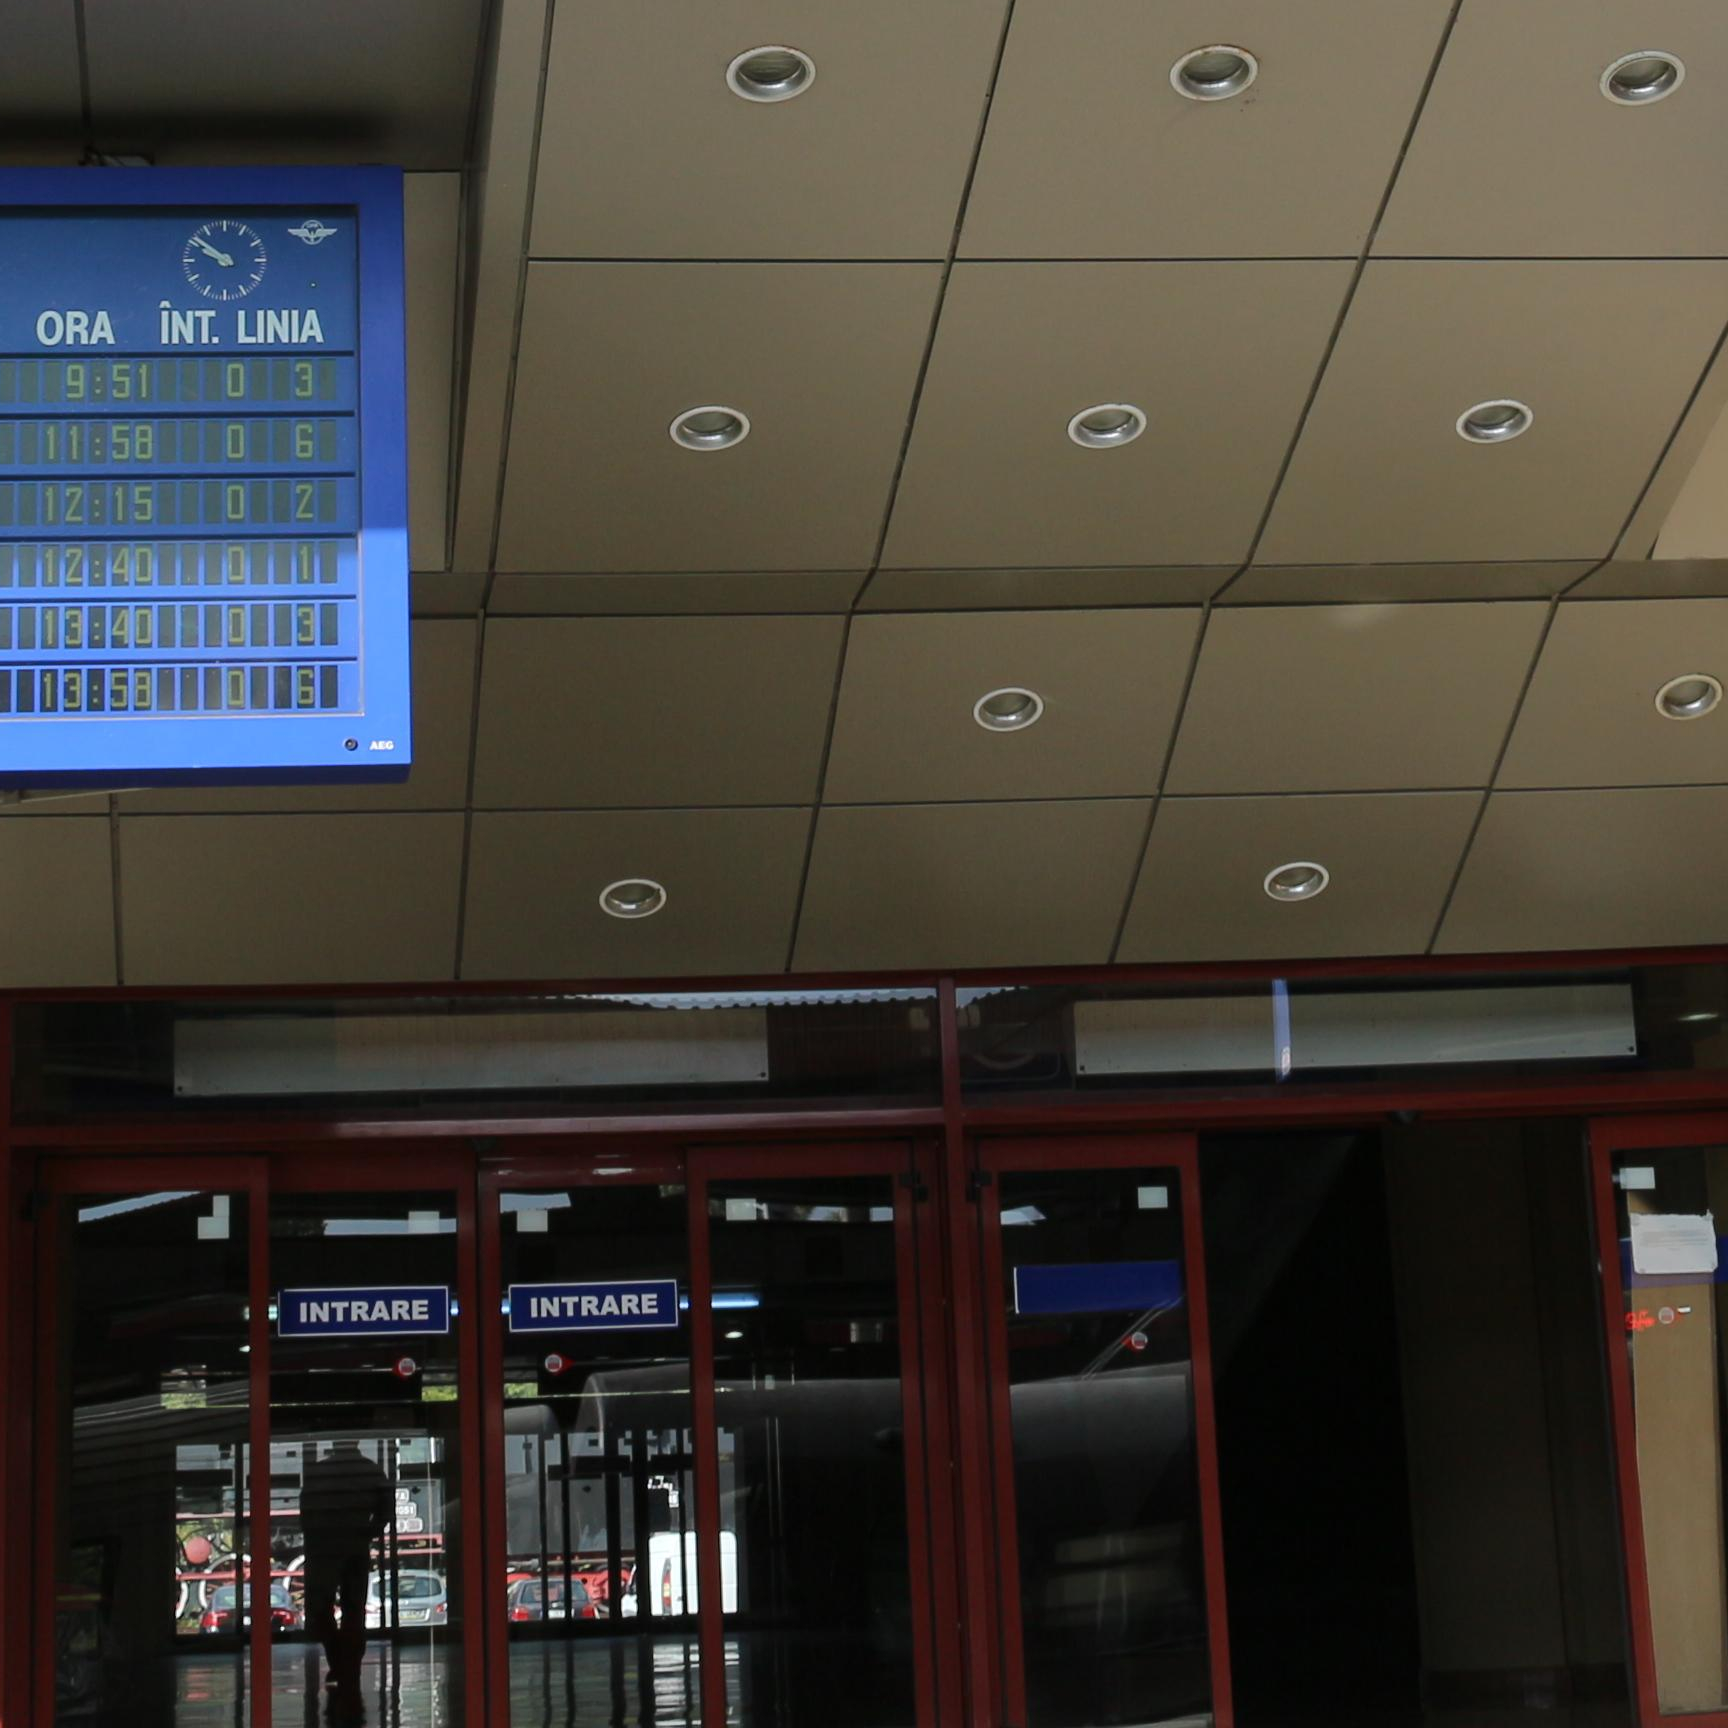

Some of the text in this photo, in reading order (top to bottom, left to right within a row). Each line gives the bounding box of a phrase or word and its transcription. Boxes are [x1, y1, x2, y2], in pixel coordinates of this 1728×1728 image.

[36, 310, 116, 346] ORA
[159, 300, 220, 344] ÎNT.
[237, 309, 324, 343] LINIA
[66, 363, 148, 398] 9:51
[227, 362, 245, 397] 0
[295, 362, 313, 397] 3
[46, 424, 153, 460] 11:58
[227, 424, 245, 459] 0
[295, 424, 313, 458] 6
[46, 486, 153, 521] 12:15
[227, 485, 245, 520] 0
[295, 485, 313, 519] 2
[45, 547, 152, 584] 12:40
[227, 546, 245, 581] 0
[299, 546, 310, 580] 1
[44, 608, 152, 645] 13:40
[228, 607, 245, 644] 0
[297, 607, 314, 643] 3
[43, 671, 152, 708] 13:58
[228, 670, 245, 706] 0
[297, 669, 314, 704] 6
[369, 740, 394, 751] AEG
[299, 1299, 429, 1323] INTRARE
[530, 1293, 658, 1318] INTRARE
